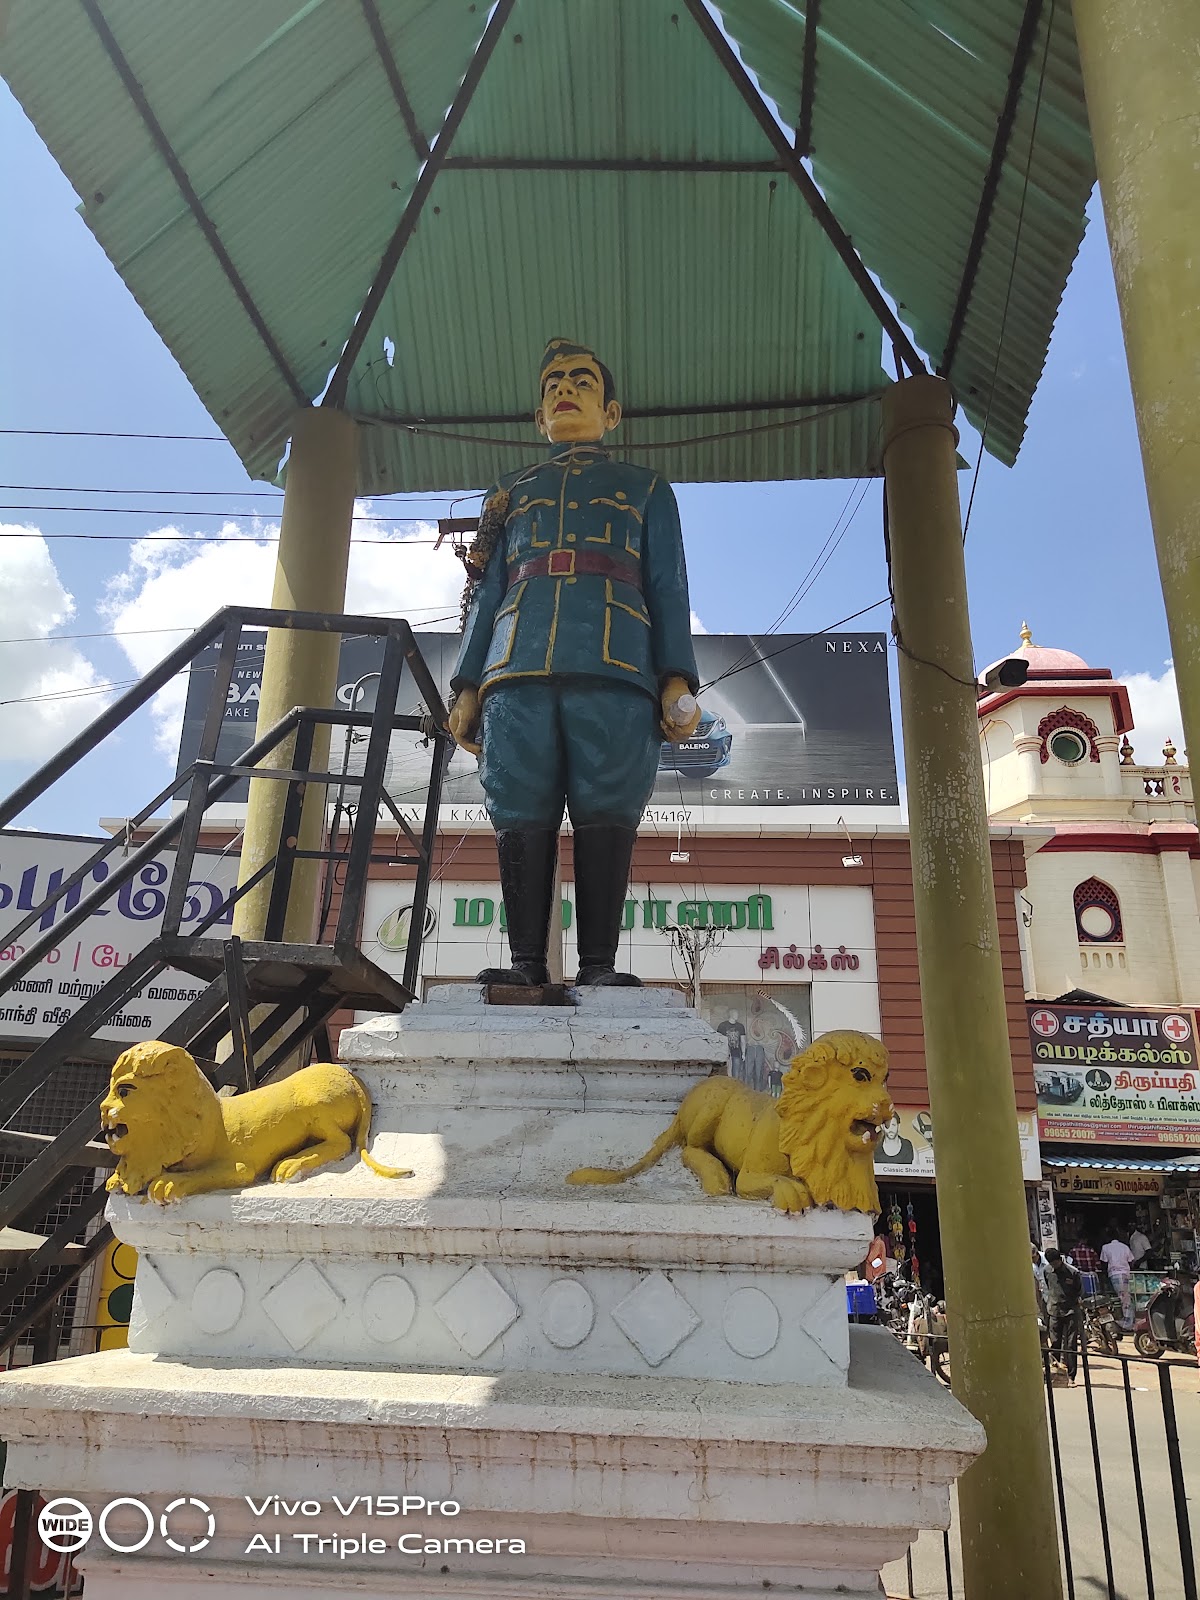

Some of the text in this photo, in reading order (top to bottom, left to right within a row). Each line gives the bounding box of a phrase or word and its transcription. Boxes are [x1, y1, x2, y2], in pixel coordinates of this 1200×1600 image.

[825, 641, 885, 653] NEXA
[237, 671, 261, 679] NEW
[710, 788, 894, 800] CREATE. INSPIRE.
[758, 944, 860, 971] சில்க்ஸ்
[1063, 1012, 1159, 1041] சத்யா
[1036, 1040, 1192, 1064] மெடிக்கல்ஸ்
[1114, 1070, 1197, 1093] திருப்பதி
